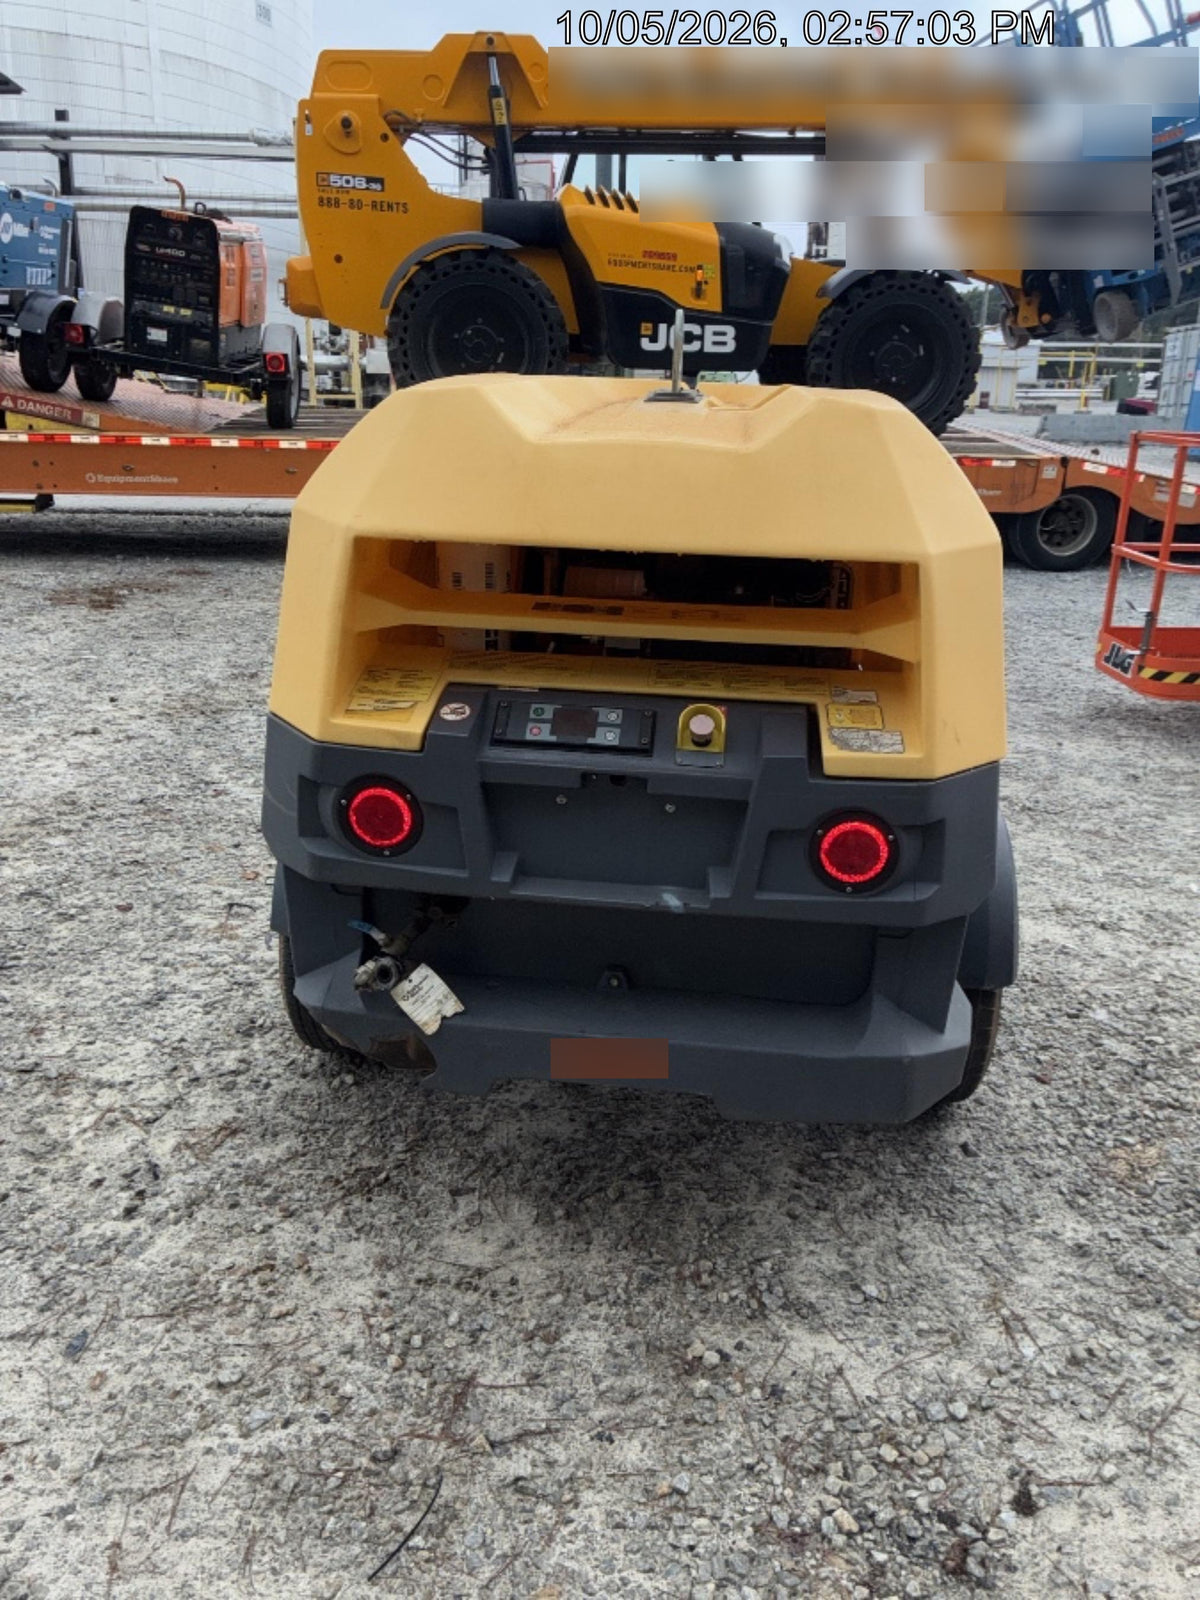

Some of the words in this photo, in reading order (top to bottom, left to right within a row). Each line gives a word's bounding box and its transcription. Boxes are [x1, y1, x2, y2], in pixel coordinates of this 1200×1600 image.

[640, 322, 737, 353] JCB
[17, 399, 72, 420] DANGER
[1104, 643, 1135, 675] JLG
